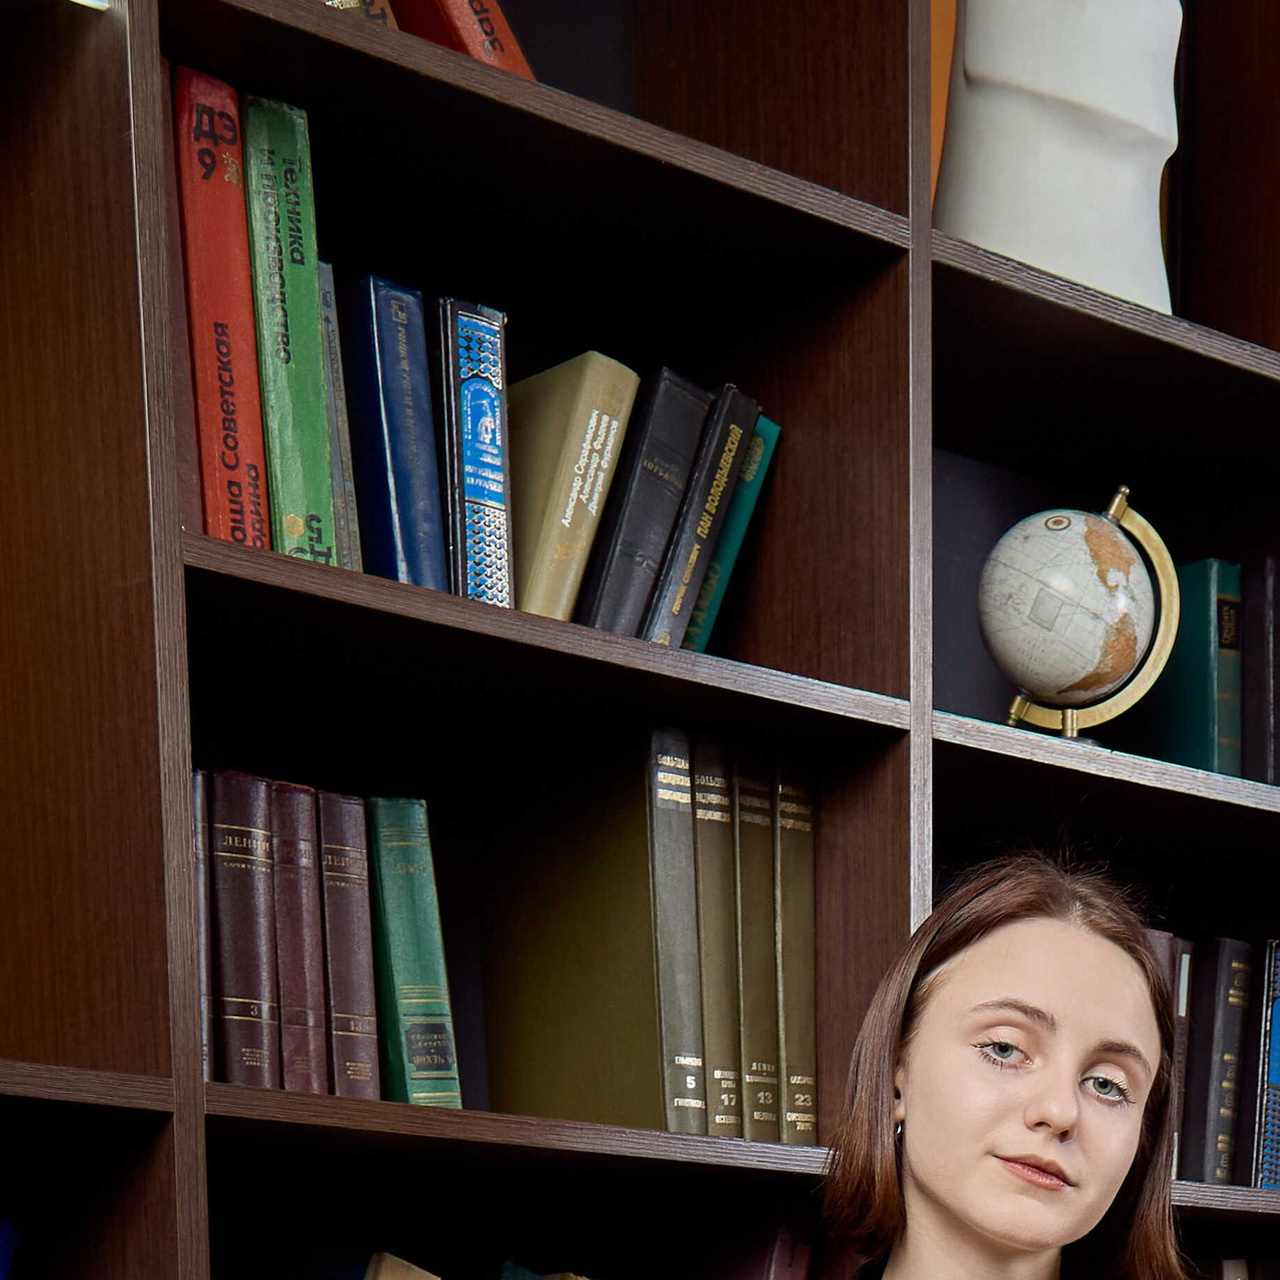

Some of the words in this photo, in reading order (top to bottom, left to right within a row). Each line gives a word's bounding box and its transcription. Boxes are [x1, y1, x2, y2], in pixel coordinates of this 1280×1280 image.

[468, 0, 505, 58] Зар
[194, 103, 238, 147] ДЭ
[197, 147, 217, 180] 9
[260, 148, 277, 168] и
[282, 156, 307, 266] Техника
[260, 172, 293, 366] производство
[214, 322, 241, 471] Советская
[561, 476, 582, 528] Александр
[574, 409, 599, 475] Серафимович
[579, 452, 600, 504] Александр
[702, 423, 745, 514] ВОЛОДЫЕВСКИЙ
[224, 479, 247, 544] аша
[245, 463, 267, 551] одина
[694, 512, 713, 539] ПАН
[223, 835, 270, 851] ЛЕНИН
[323, 853, 368, 868] ЛЕНИН
[250, 1004, 259, 1016] 3
[686, 1076, 696, 1089] 5
[721, 1093, 737, 1106] 17
[757, 1091, 773, 1104] 13
[794, 1093, 812, 1107] 23
